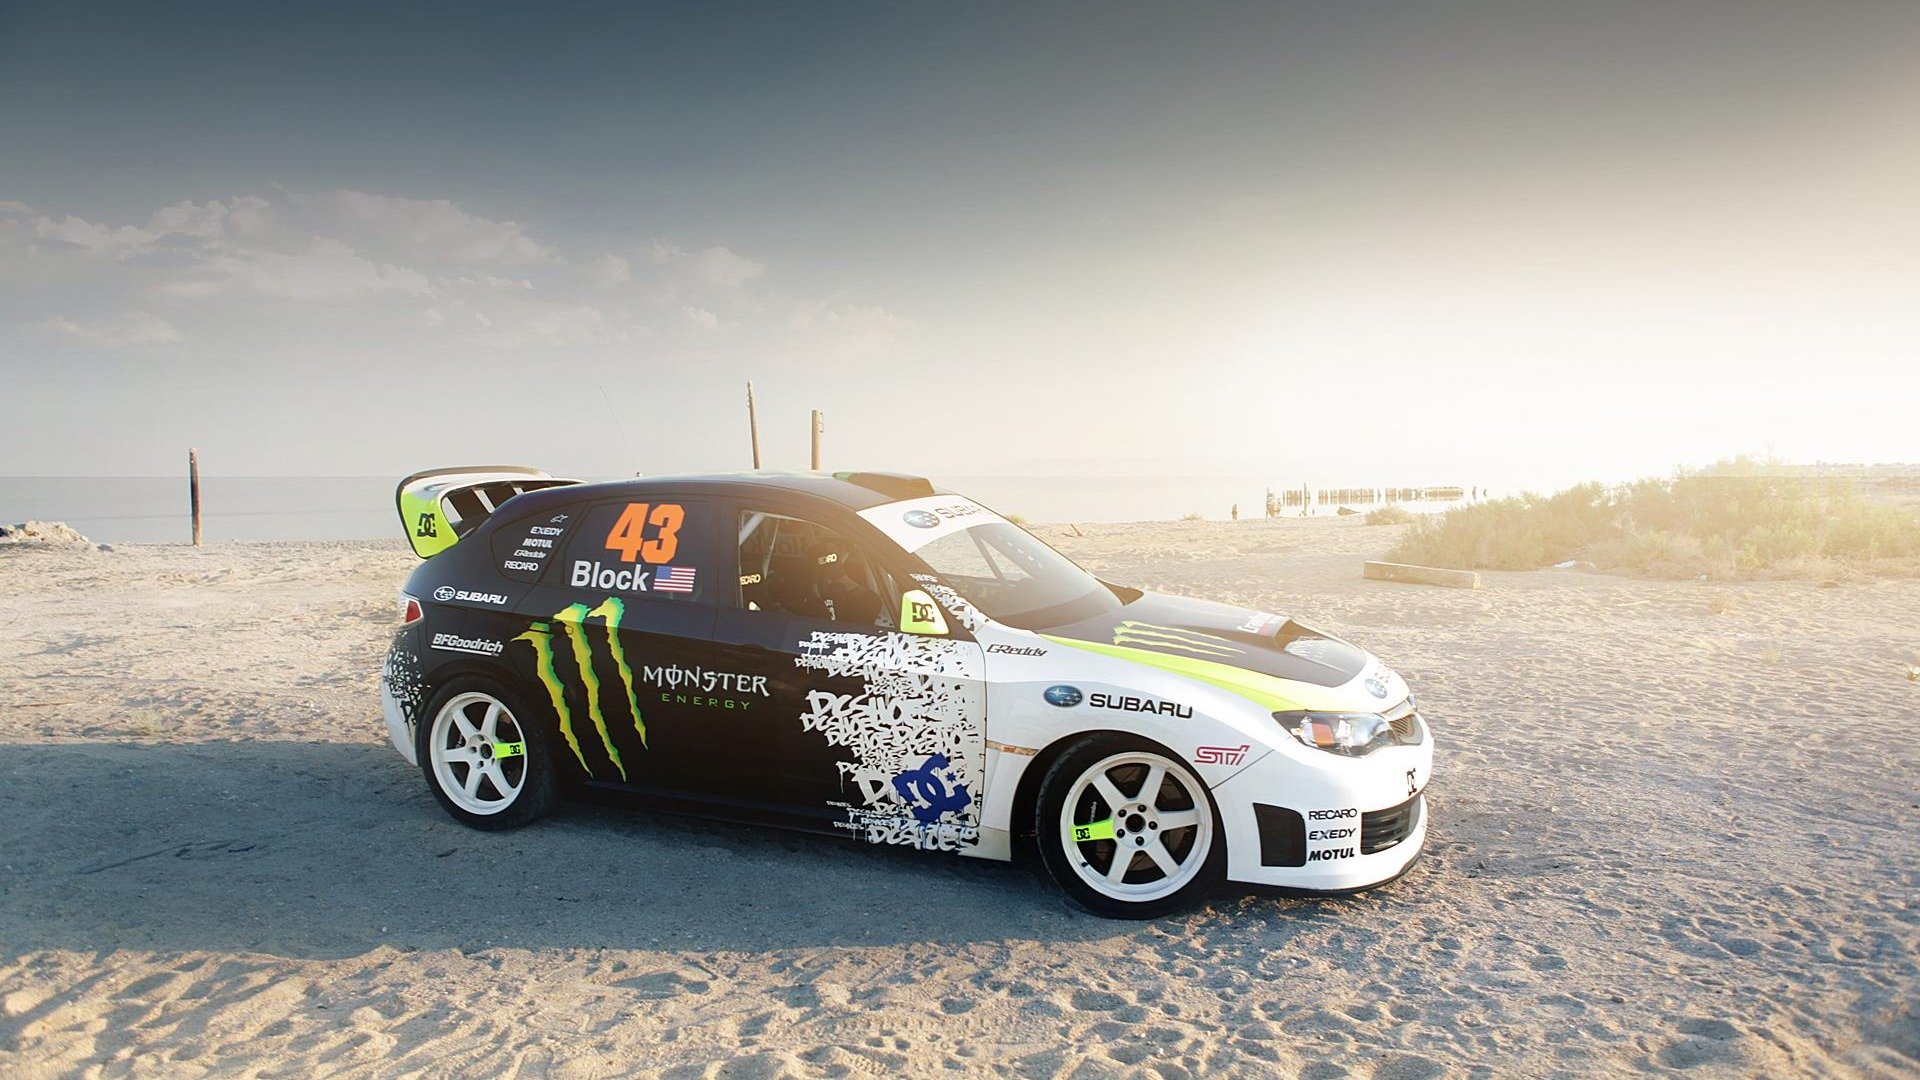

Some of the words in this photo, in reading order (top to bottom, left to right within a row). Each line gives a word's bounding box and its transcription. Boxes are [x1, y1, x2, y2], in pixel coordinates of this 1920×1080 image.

[530, 526, 563, 536] EXEDY
[605, 502, 686, 564] 43
[522, 538, 552, 548] MOTUL
[504, 560, 539, 571] RECARO
[570, 560, 650, 592] Block
[740, 573, 761, 585] ECARO
[455, 590, 508, 605] SUBARU
[432, 633, 504, 653] BFGoodrich
[986, 644, 1048, 657] GReddy
[642, 663, 770, 697] MONSTER
[661, 693, 751, 710] ENERGY
[1089, 692, 1194, 719] SUBARU
[1308, 808, 1358, 820] RECARO
[1308, 828, 1357, 841] EXEDY
[1308, 847, 1355, 862] MOTUL
